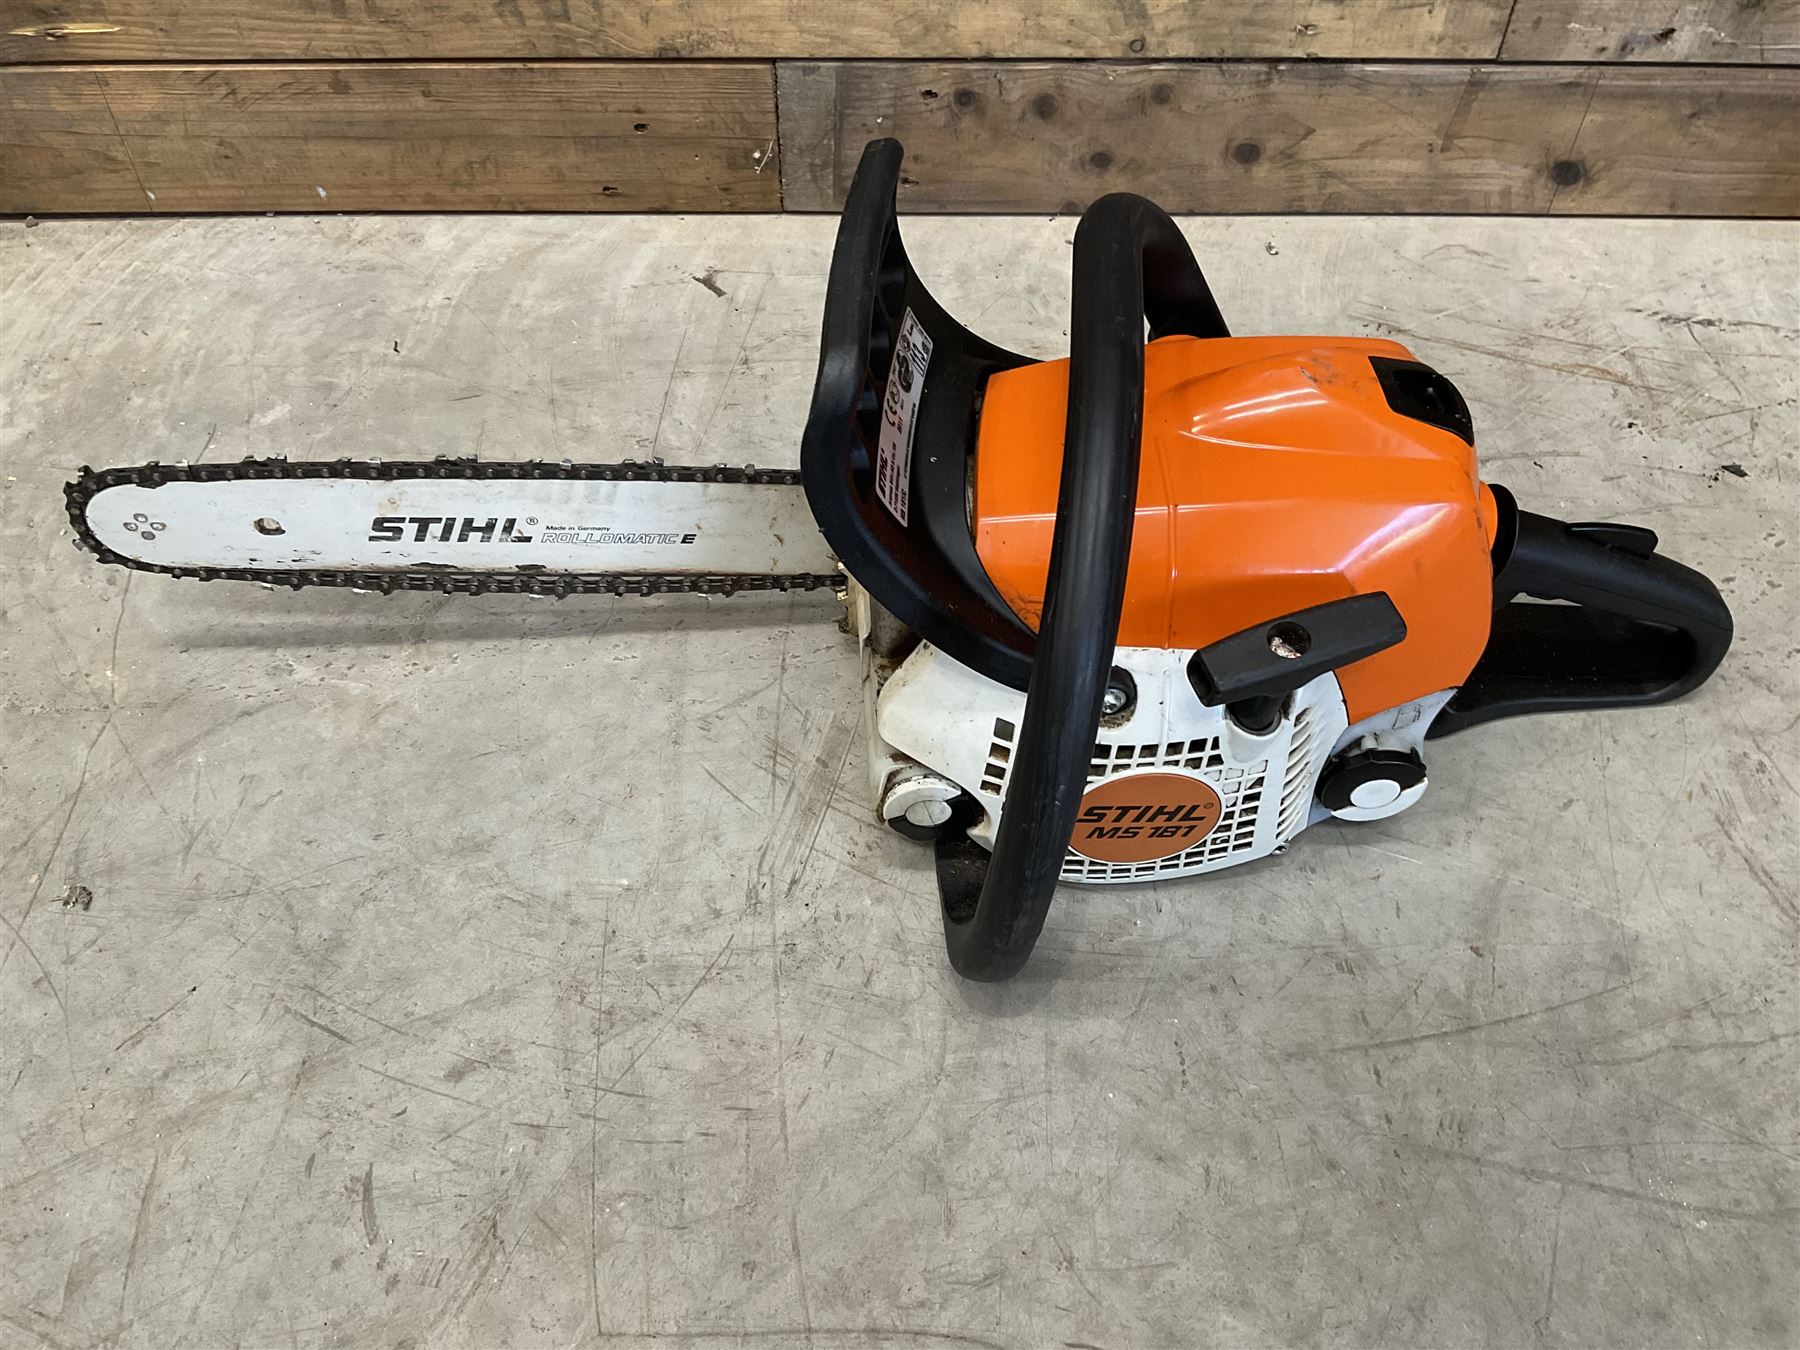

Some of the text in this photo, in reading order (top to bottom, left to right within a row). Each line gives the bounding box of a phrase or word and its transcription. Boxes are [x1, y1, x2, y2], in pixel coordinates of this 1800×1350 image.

[368, 516, 533, 543] STIHL
[541, 532, 680, 544] ROLLOMATIC
[1076, 804, 1206, 823] STIHL
[1086, 825, 1198, 839] MS 181
